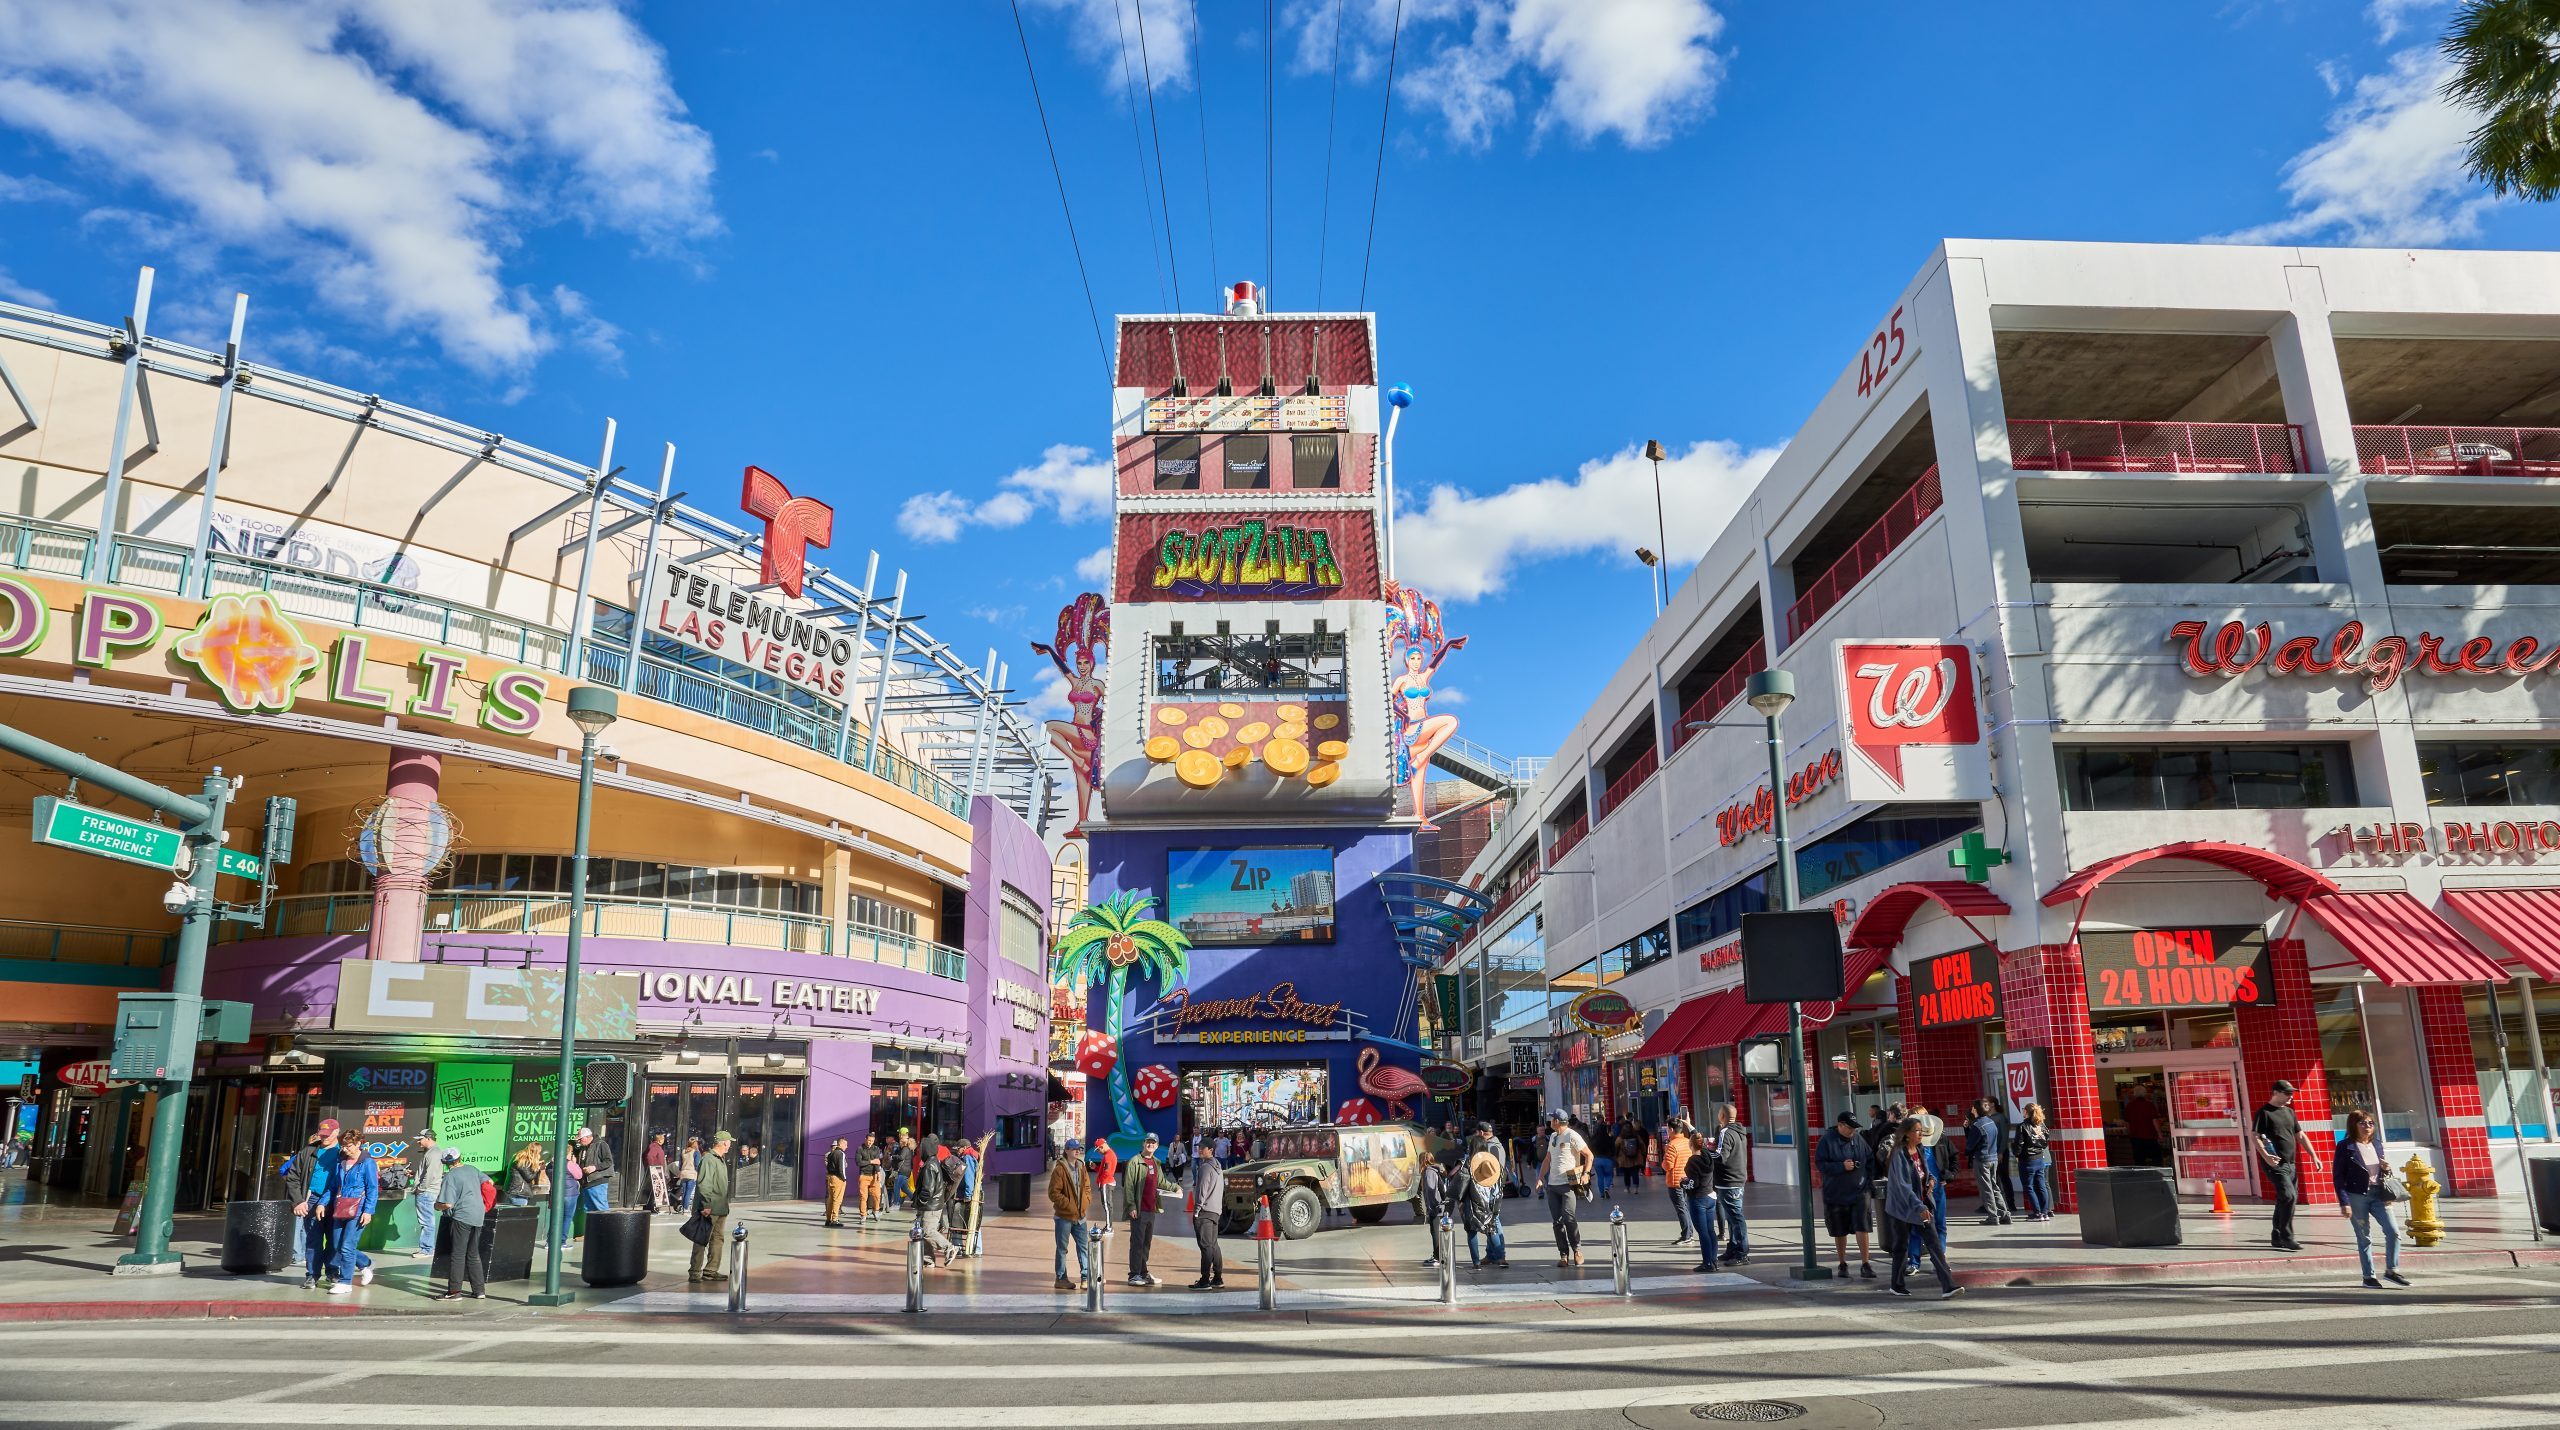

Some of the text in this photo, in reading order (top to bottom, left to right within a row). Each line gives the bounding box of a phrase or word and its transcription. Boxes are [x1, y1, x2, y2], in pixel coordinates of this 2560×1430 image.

[1858, 305, 1904, 398] 425
[210, 512, 233, 524] 2ND
[241, 518, 284, 537] FLOOR
[291, 529, 335, 547] ABOVE
[209, 525, 358, 583] NERD
[1152, 517, 1346, 589] SLOTZILLA
[667, 565, 850, 665] TELEMUNDO
[659, 599, 846, 696] LAS VEGAS
[2171, 620, 2560, 692] Walgree
[1716, 748, 1843, 847] Walgeen
[79, 831, 153, 857] EXPERIENCE
[82, 816, 159, 844] FREMONT ST
[2329, 821, 2560, 853] 1-HR PHOTO
[223, 855, 264, 875] E 400
[1700, 940, 1742, 972] PHARMAC
[2133, 930, 2216, 967] OPEN
[1932, 952, 1972, 990] OPEN
[2100, 966, 2258, 1005] 24 HOURS
[772, 980, 882, 1015] EATERY
[1158, 981, 1342, 1040] Fremont Street
[1447, 979, 1458, 1029] BRASS
[1919, 982, 1995, 1026] 24 HOURS
[1199, 1030, 1306, 1044] EXPERIENCE
[1513, 1046, 1533, 1056] FEAR
[373, 1068, 428, 1086] NERD
[1513, 1062, 1540, 1074] DEAD
[542, 1084, 584, 1103] BOG
[364, 1115, 404, 1126] ART
[443, 1106, 505, 1124] CANNABITION
[445, 1118, 491, 1132] CANNABIS
[514, 1121, 583, 1136] ONLE
[515, 1112, 584, 1121] BUY TICTS
[361, 1141, 409, 1158] OY
[446, 1128, 484, 1142] MUSEUM
